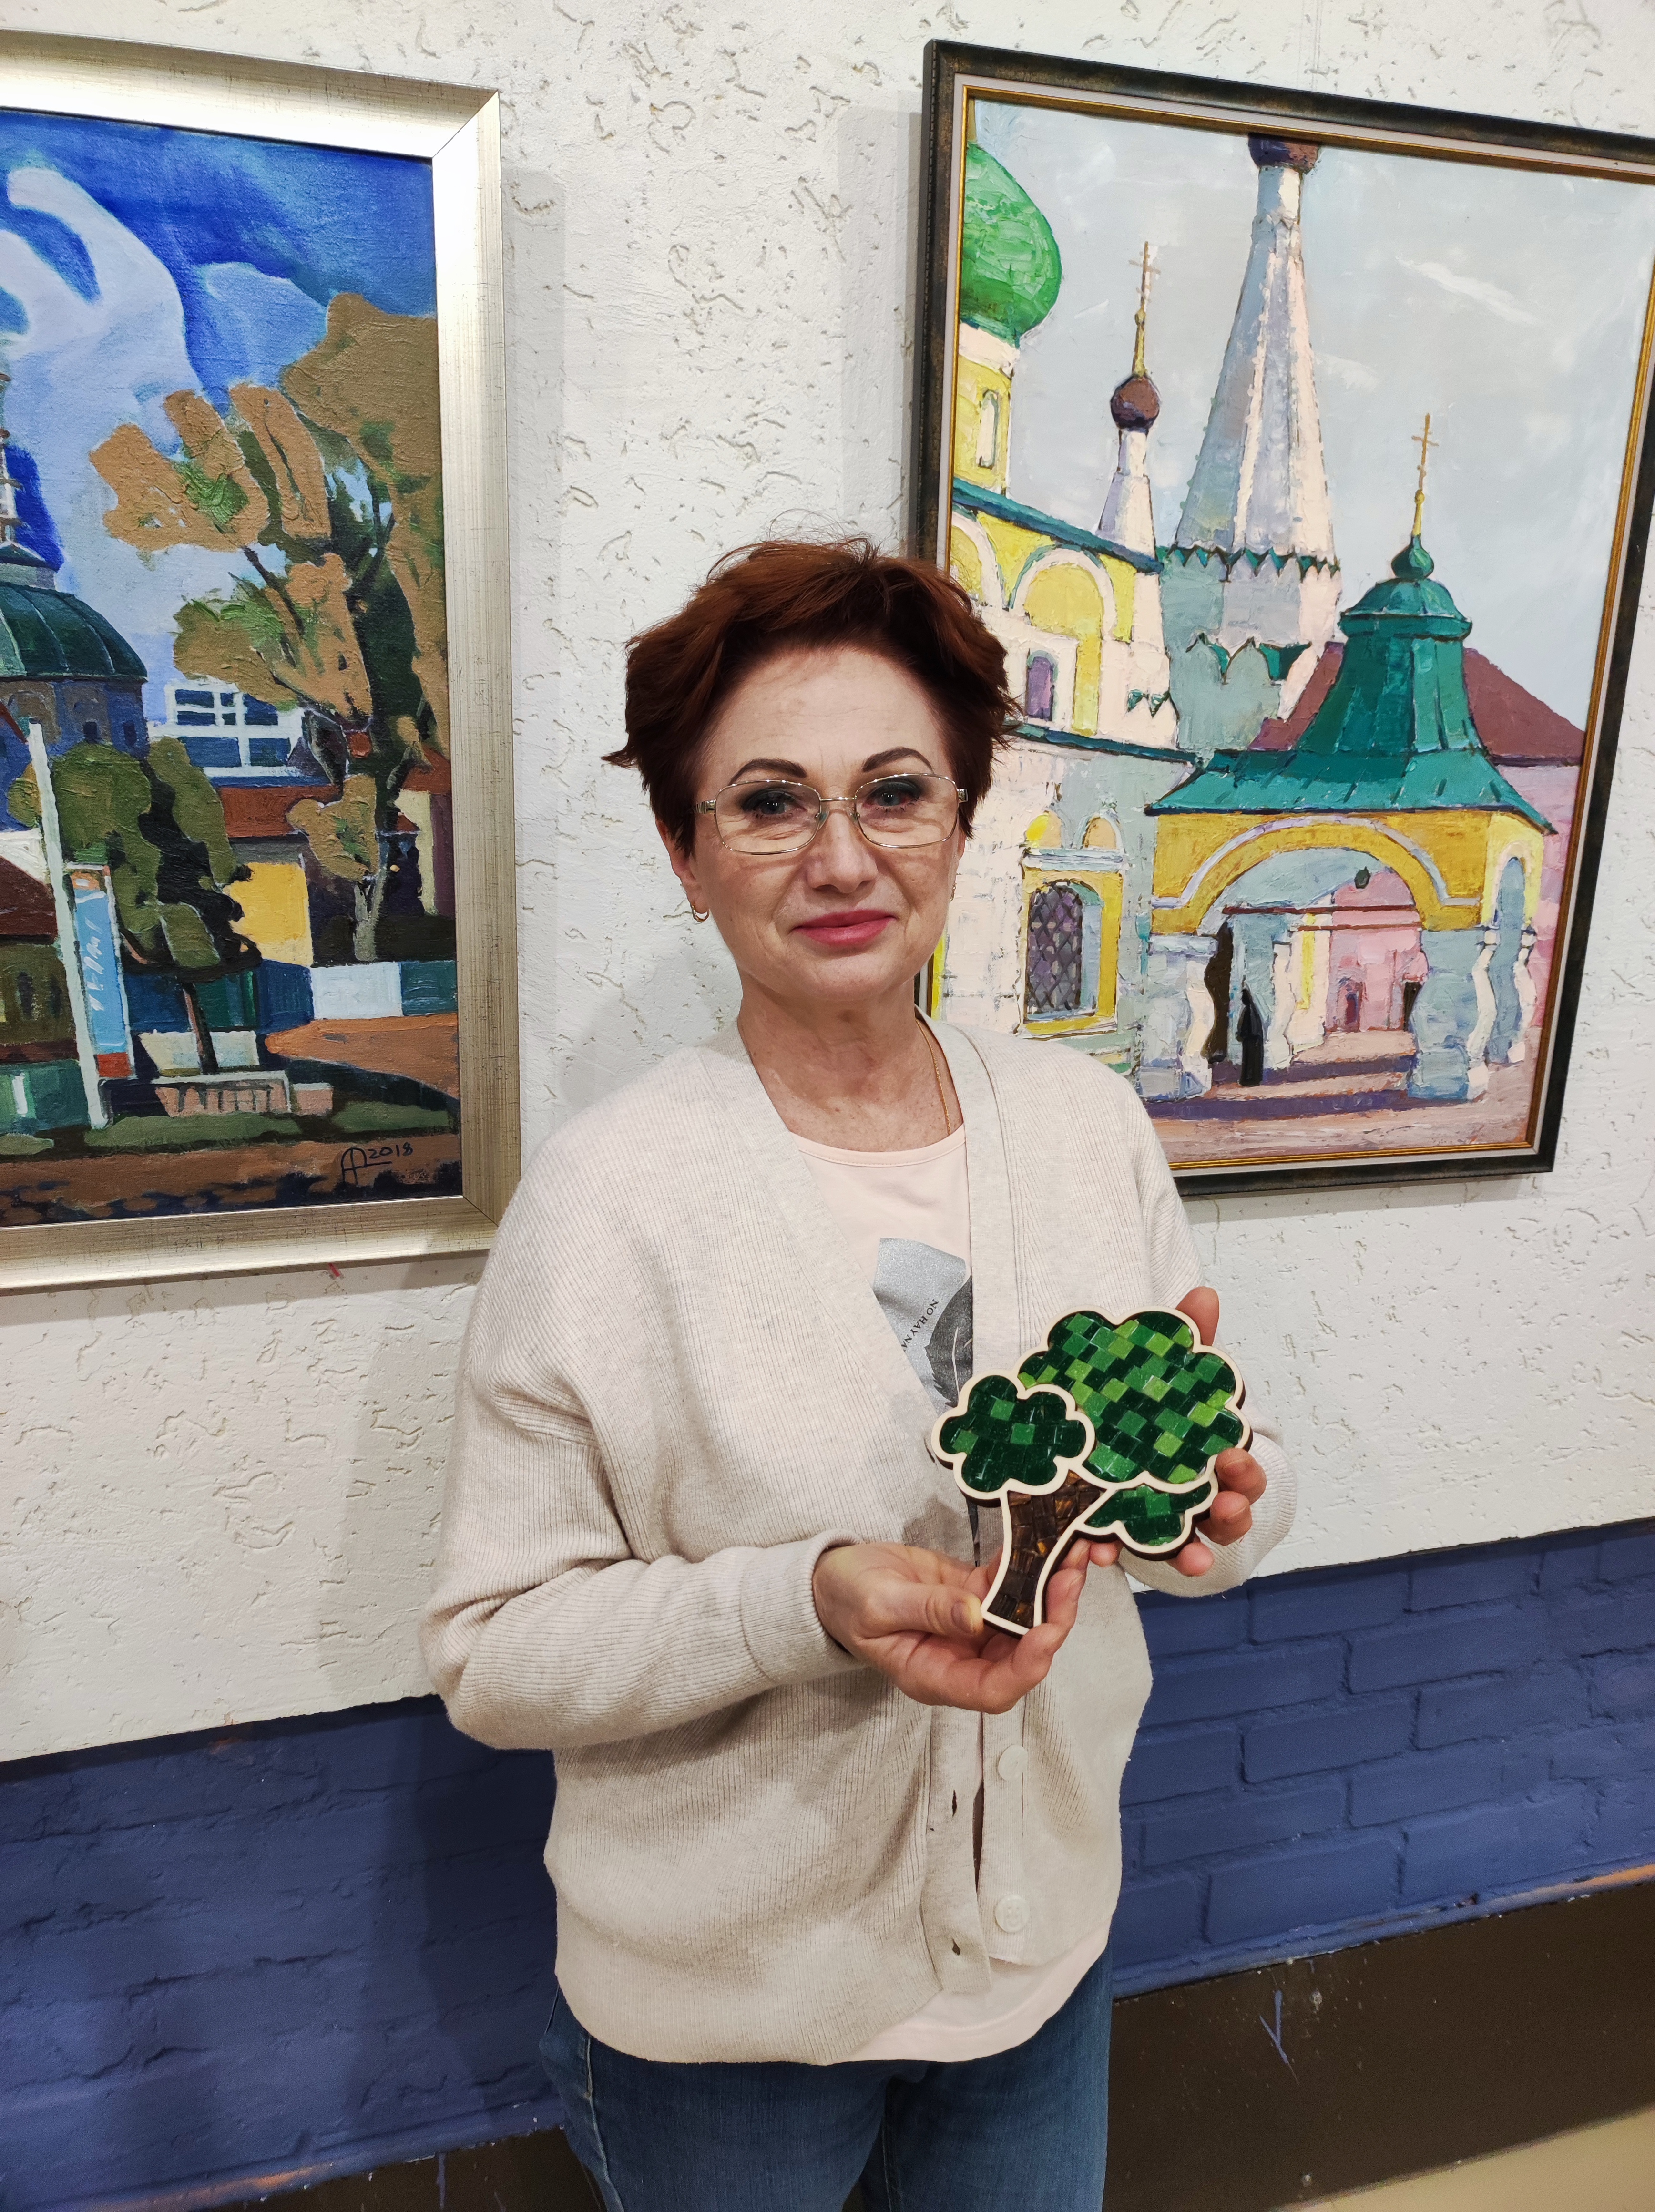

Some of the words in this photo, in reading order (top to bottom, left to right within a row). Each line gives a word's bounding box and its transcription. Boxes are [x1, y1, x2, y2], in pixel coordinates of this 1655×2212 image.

[368, 1142, 413, 1159] 2018
[927, 1299, 939, 1315] NO
[910, 1316, 928, 1336] HAY
